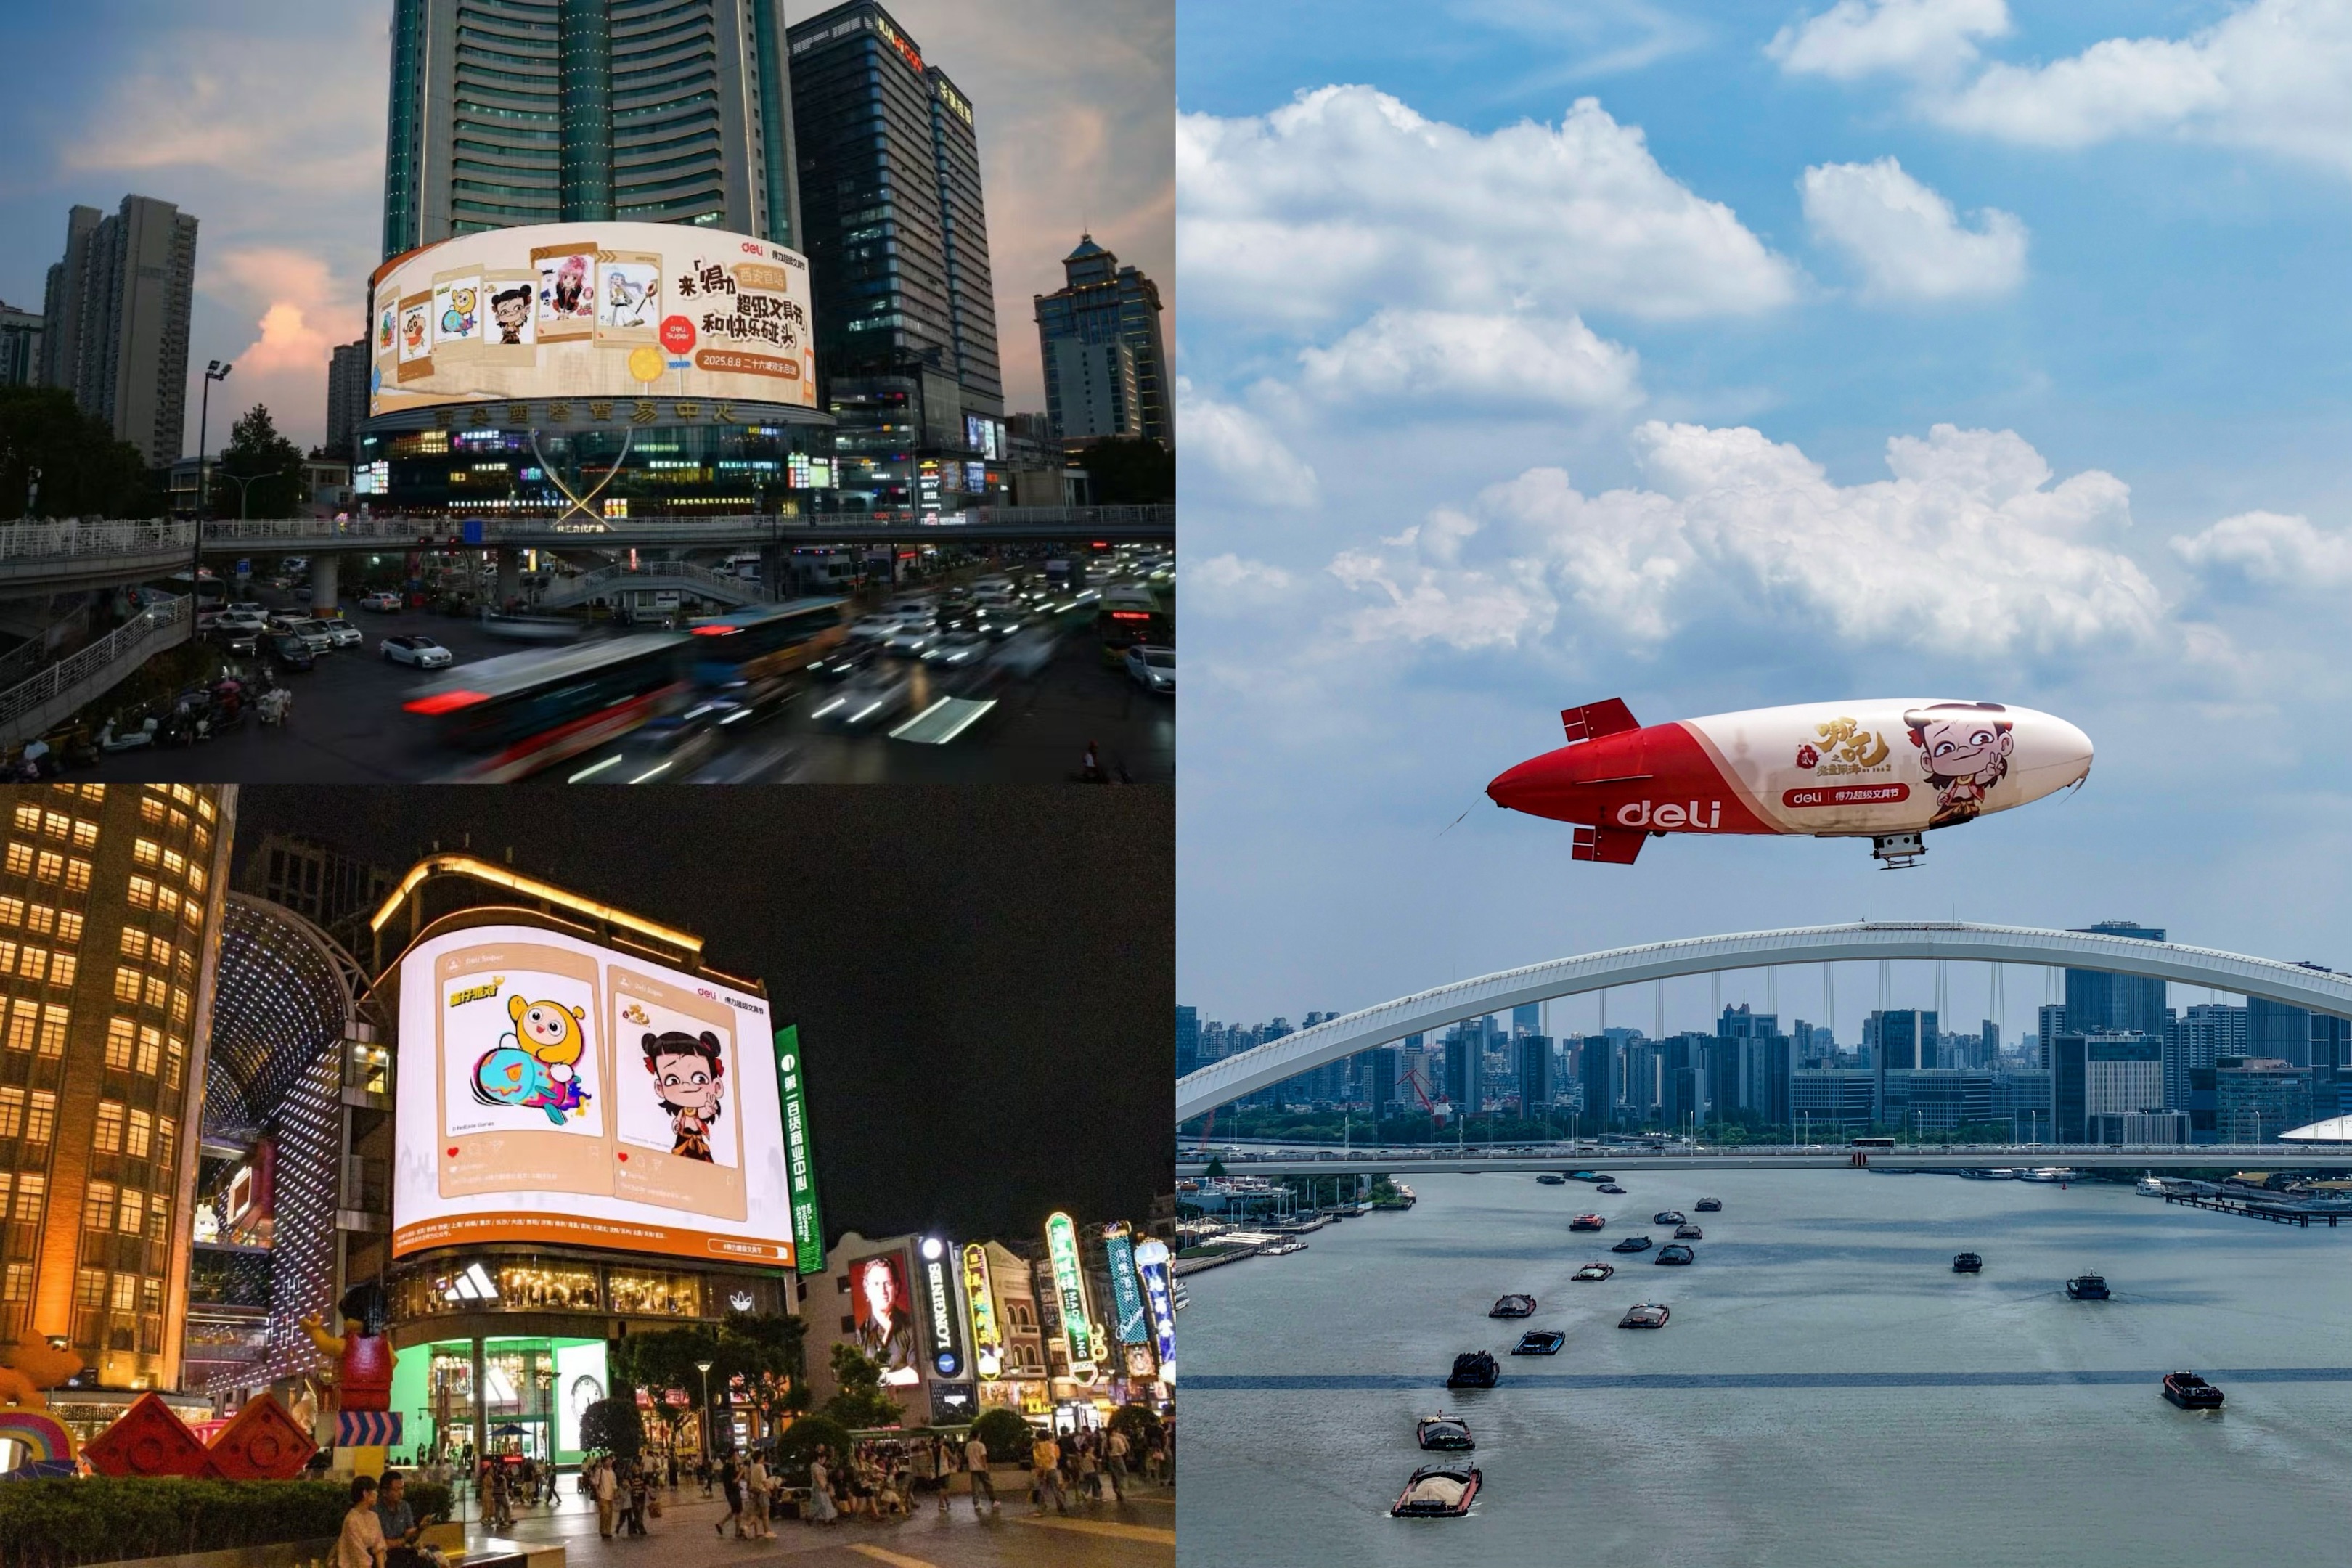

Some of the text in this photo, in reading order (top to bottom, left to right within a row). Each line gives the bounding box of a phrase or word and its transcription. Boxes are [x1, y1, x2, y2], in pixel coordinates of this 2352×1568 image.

[742, 242, 763, 256] deli
[739, 267, 784, 287] 西安首站
[701, 313, 794, 345] 和快乐碰头
[703, 355, 741, 368] 2025.8.8
[1794, 792, 1821, 804] deli
[1835, 788, 1900, 801] 得力超级文具节
[1617, 800, 1720, 828] deli
[698, 988, 716, 1000] deli
[724, 997, 764, 1015] 得力超级文具节
[928, 1262, 951, 1349] LONGINES
